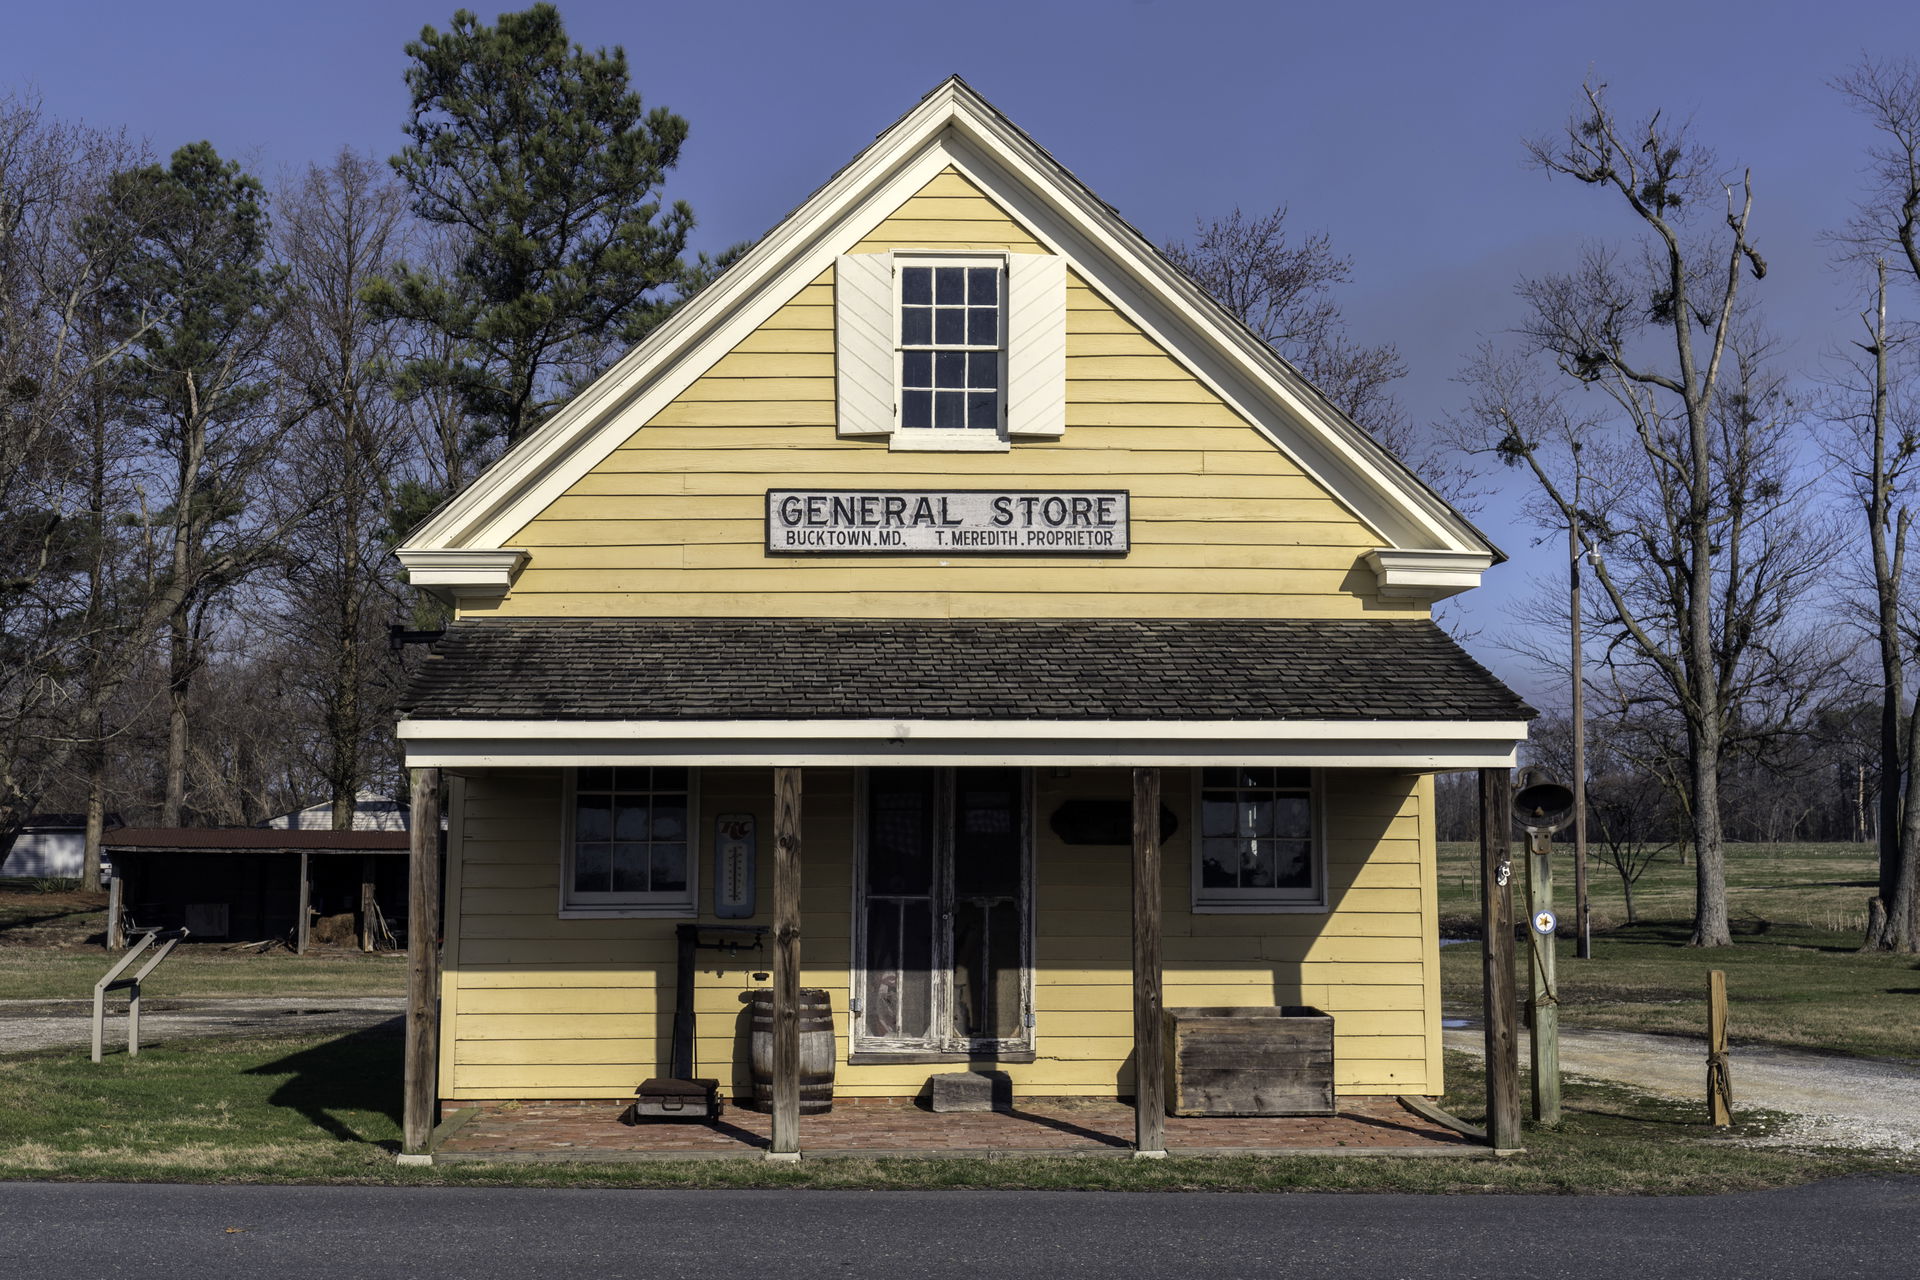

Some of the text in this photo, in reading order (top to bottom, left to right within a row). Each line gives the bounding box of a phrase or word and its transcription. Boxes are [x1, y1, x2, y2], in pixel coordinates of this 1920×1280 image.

[778, 496, 1118, 529] GENERAL STORE
[1027, 530, 1114, 547] PROPRIETOR
